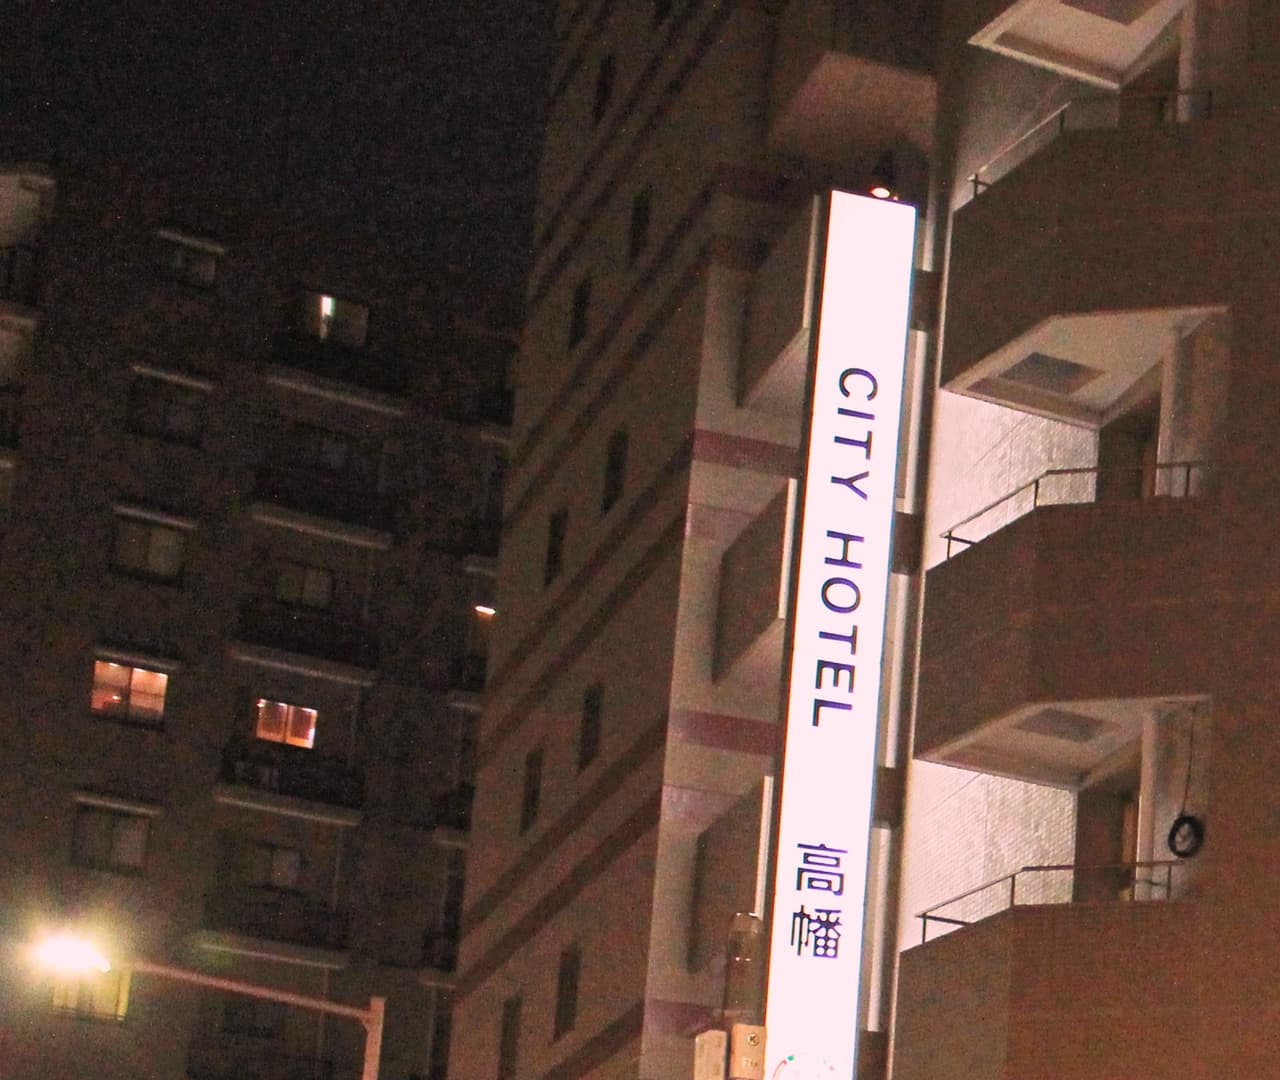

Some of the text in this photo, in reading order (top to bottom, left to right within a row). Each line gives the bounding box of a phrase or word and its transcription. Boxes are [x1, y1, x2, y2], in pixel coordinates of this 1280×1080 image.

[812, 367, 878, 727] CITY HOTEL
[790, 842, 848, 959] 高幡
